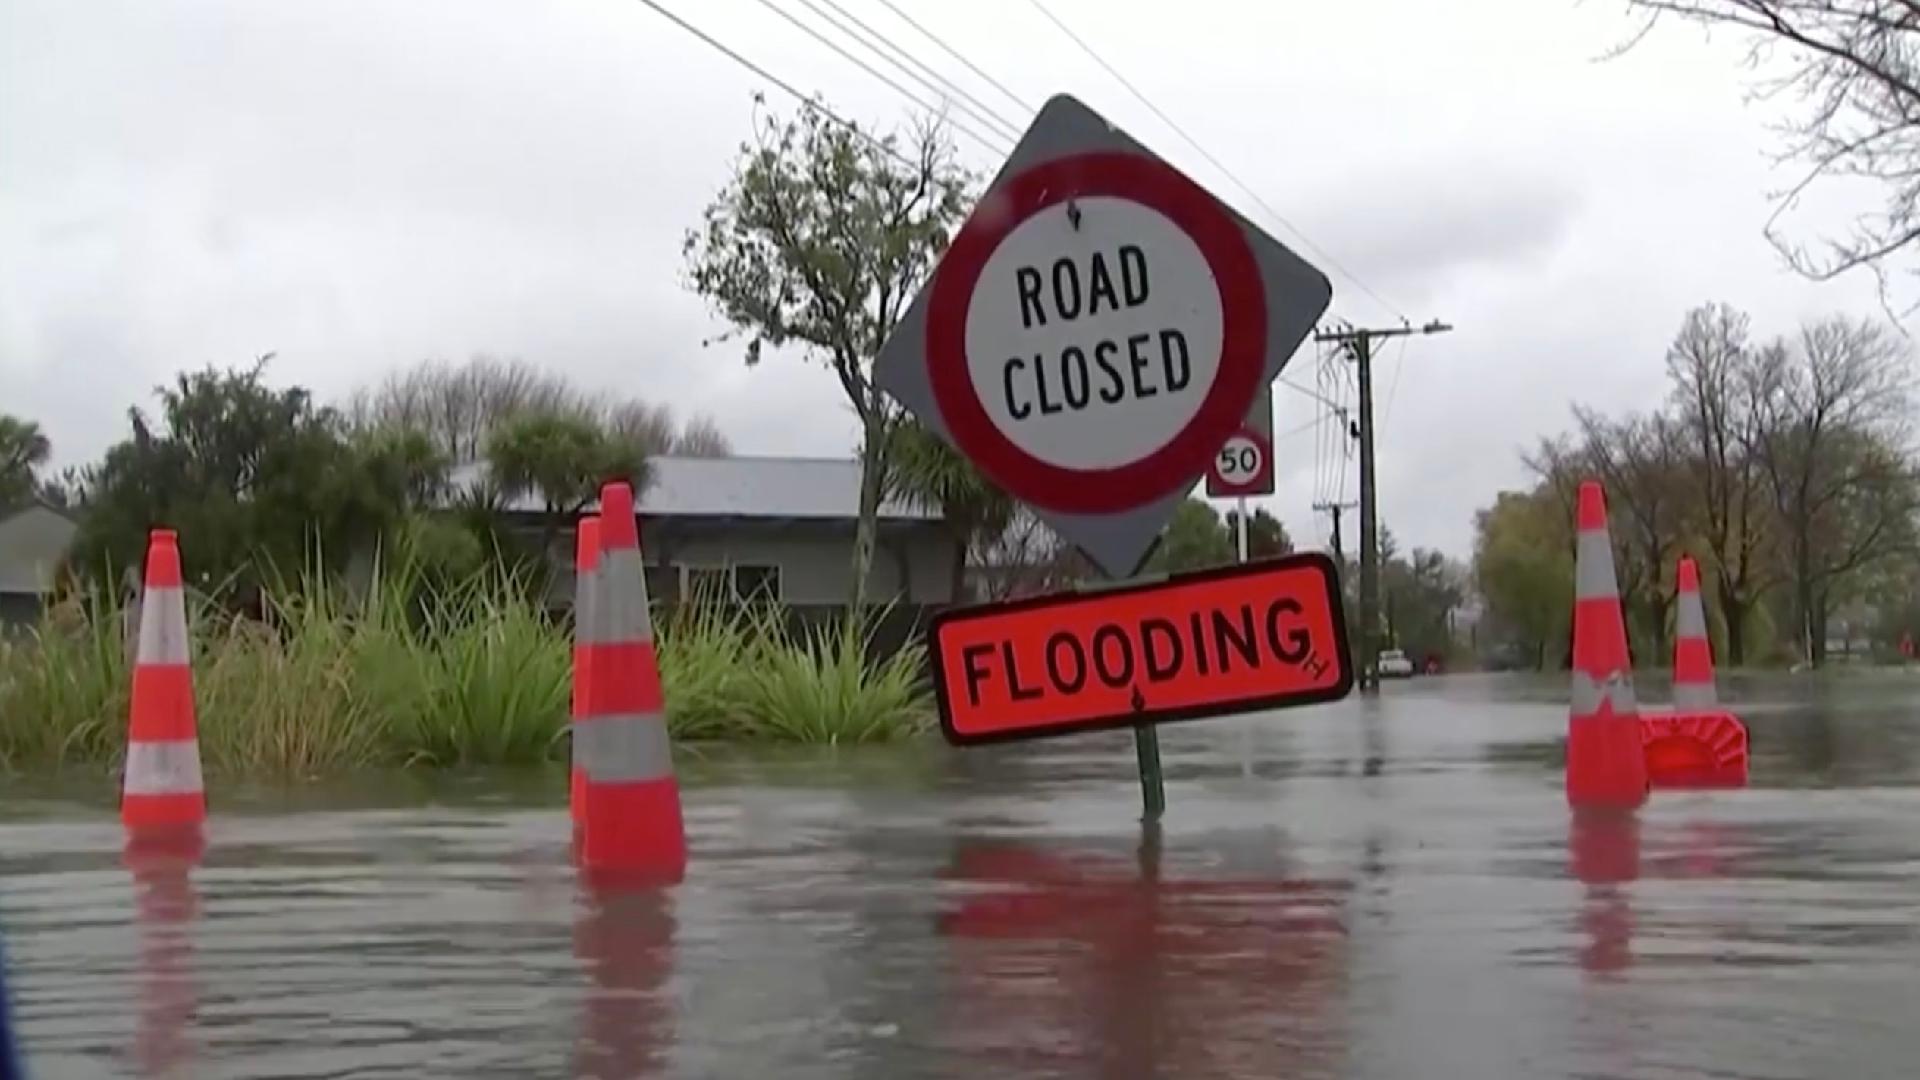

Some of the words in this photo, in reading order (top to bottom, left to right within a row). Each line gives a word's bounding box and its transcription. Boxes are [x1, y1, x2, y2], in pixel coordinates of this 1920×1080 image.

[1016, 244, 1150, 329] ROAD
[1003, 328, 1192, 420] CLOSED
[1221, 447, 1257, 473] 50
[962, 597, 1311, 707] FLOODING
